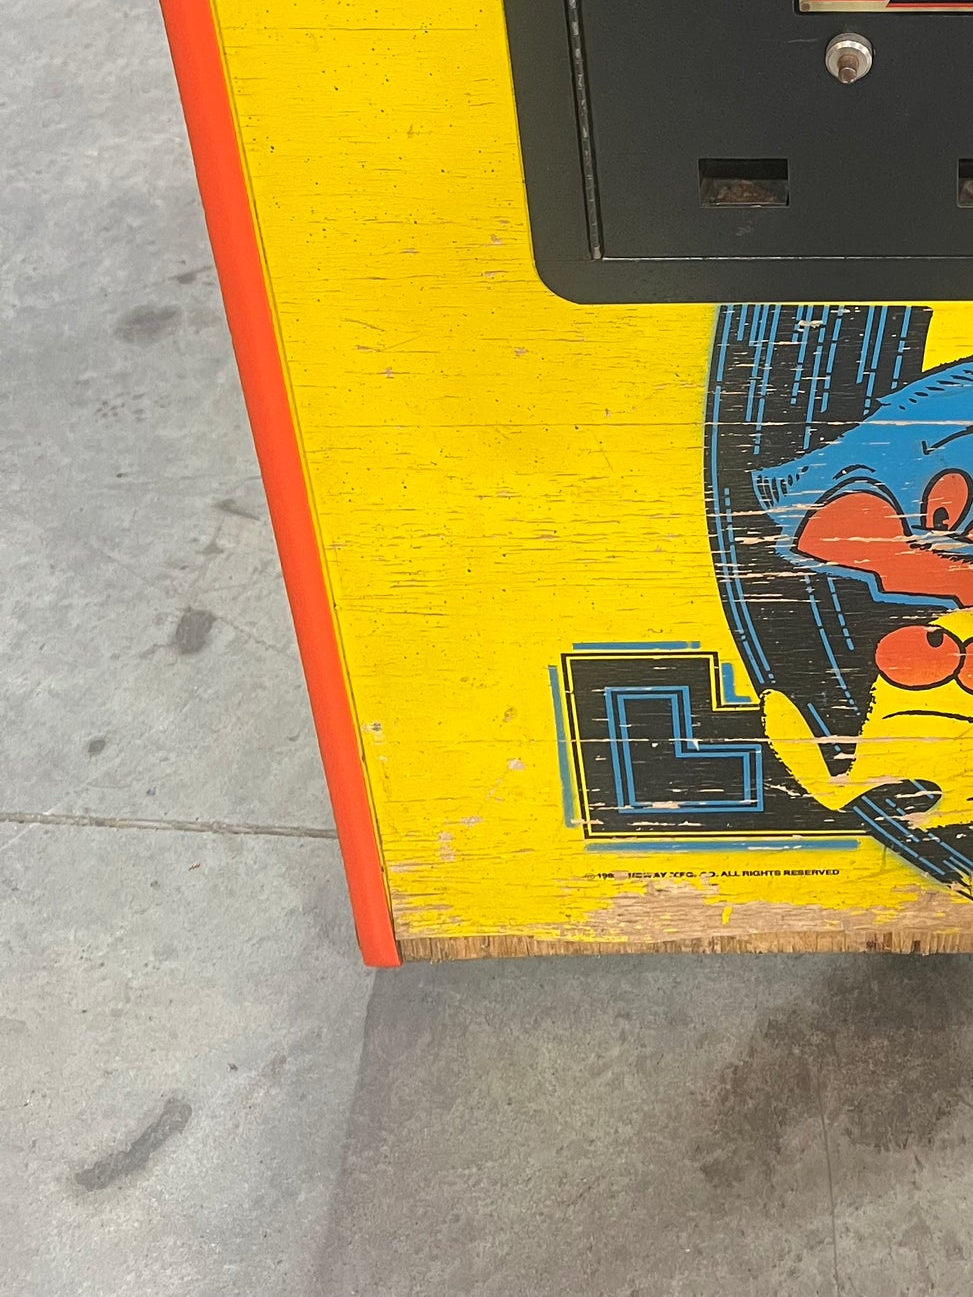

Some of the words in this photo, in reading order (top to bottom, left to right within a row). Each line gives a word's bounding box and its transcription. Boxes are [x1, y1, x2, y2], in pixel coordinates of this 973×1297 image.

[720, 870, 741, 878] ALL
[742, 869, 782, 877] RIGHTS
[783, 868, 841, 877] RESERVED
